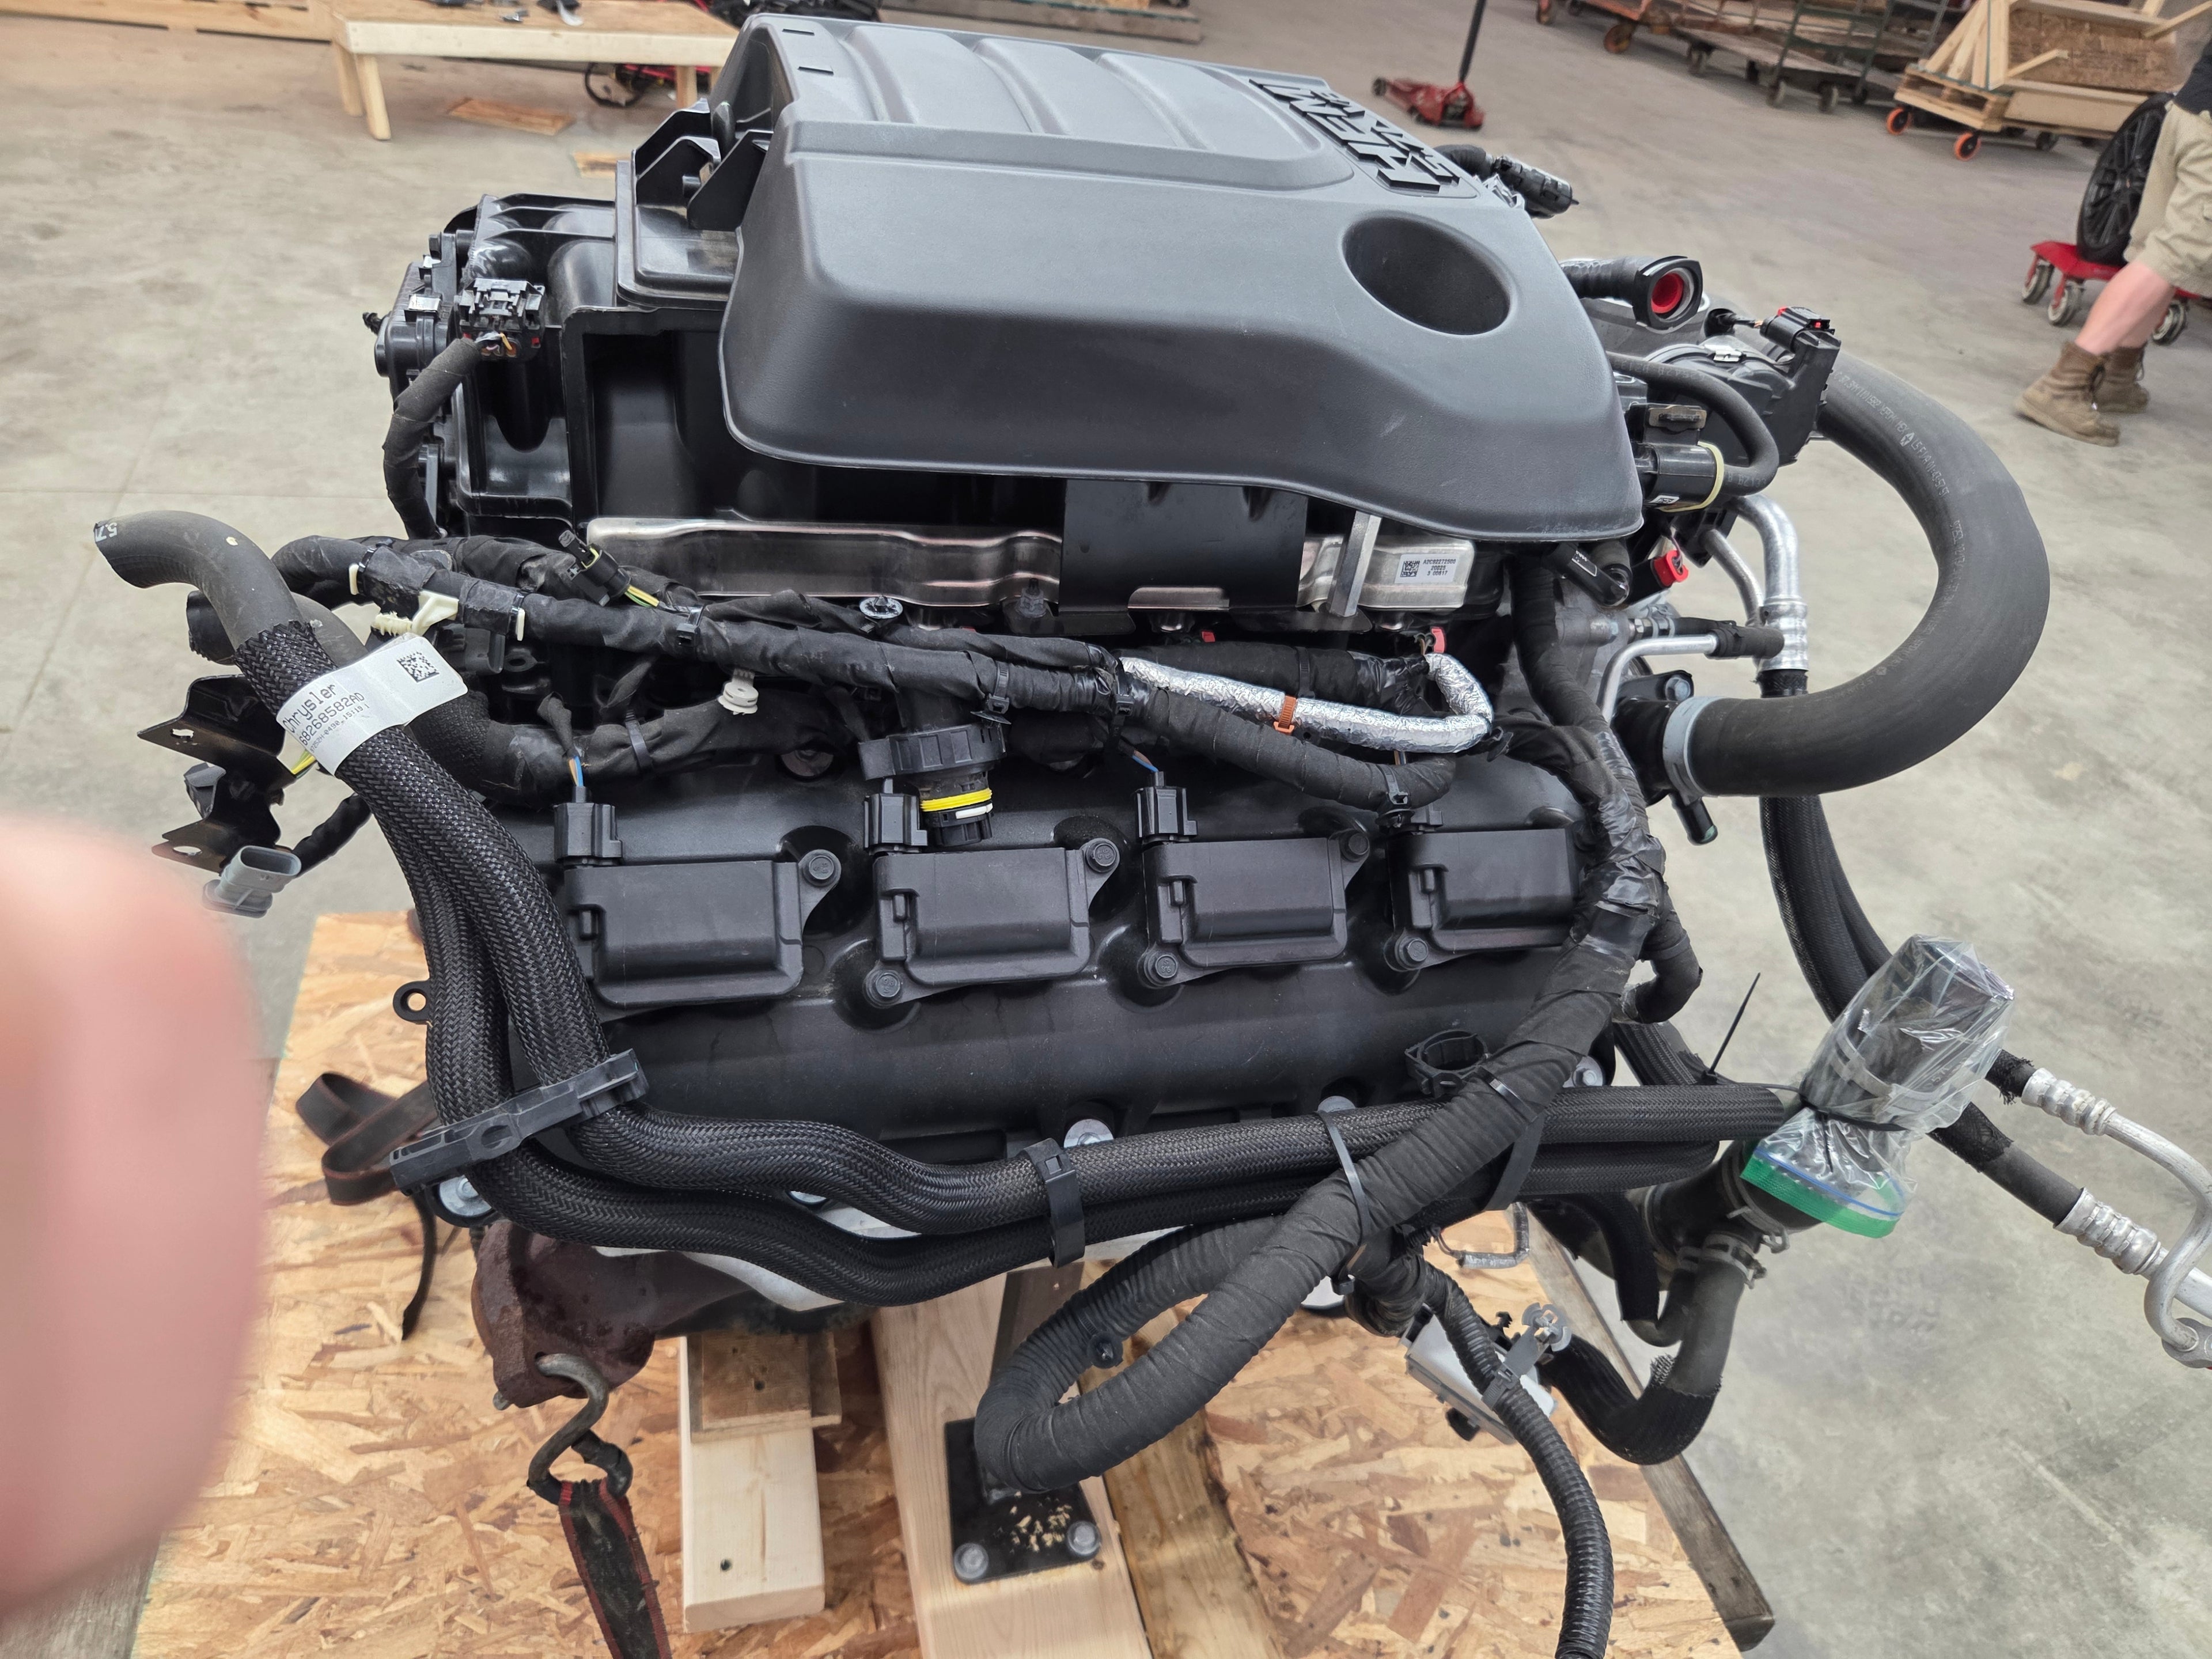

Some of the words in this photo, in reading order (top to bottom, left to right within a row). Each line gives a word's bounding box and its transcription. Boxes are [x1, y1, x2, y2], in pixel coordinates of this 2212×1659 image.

[1249, 78, 1441, 193] HEMI
[282, 684, 336, 733] Chrysler
[299, 692, 365, 746] 68268582AD
